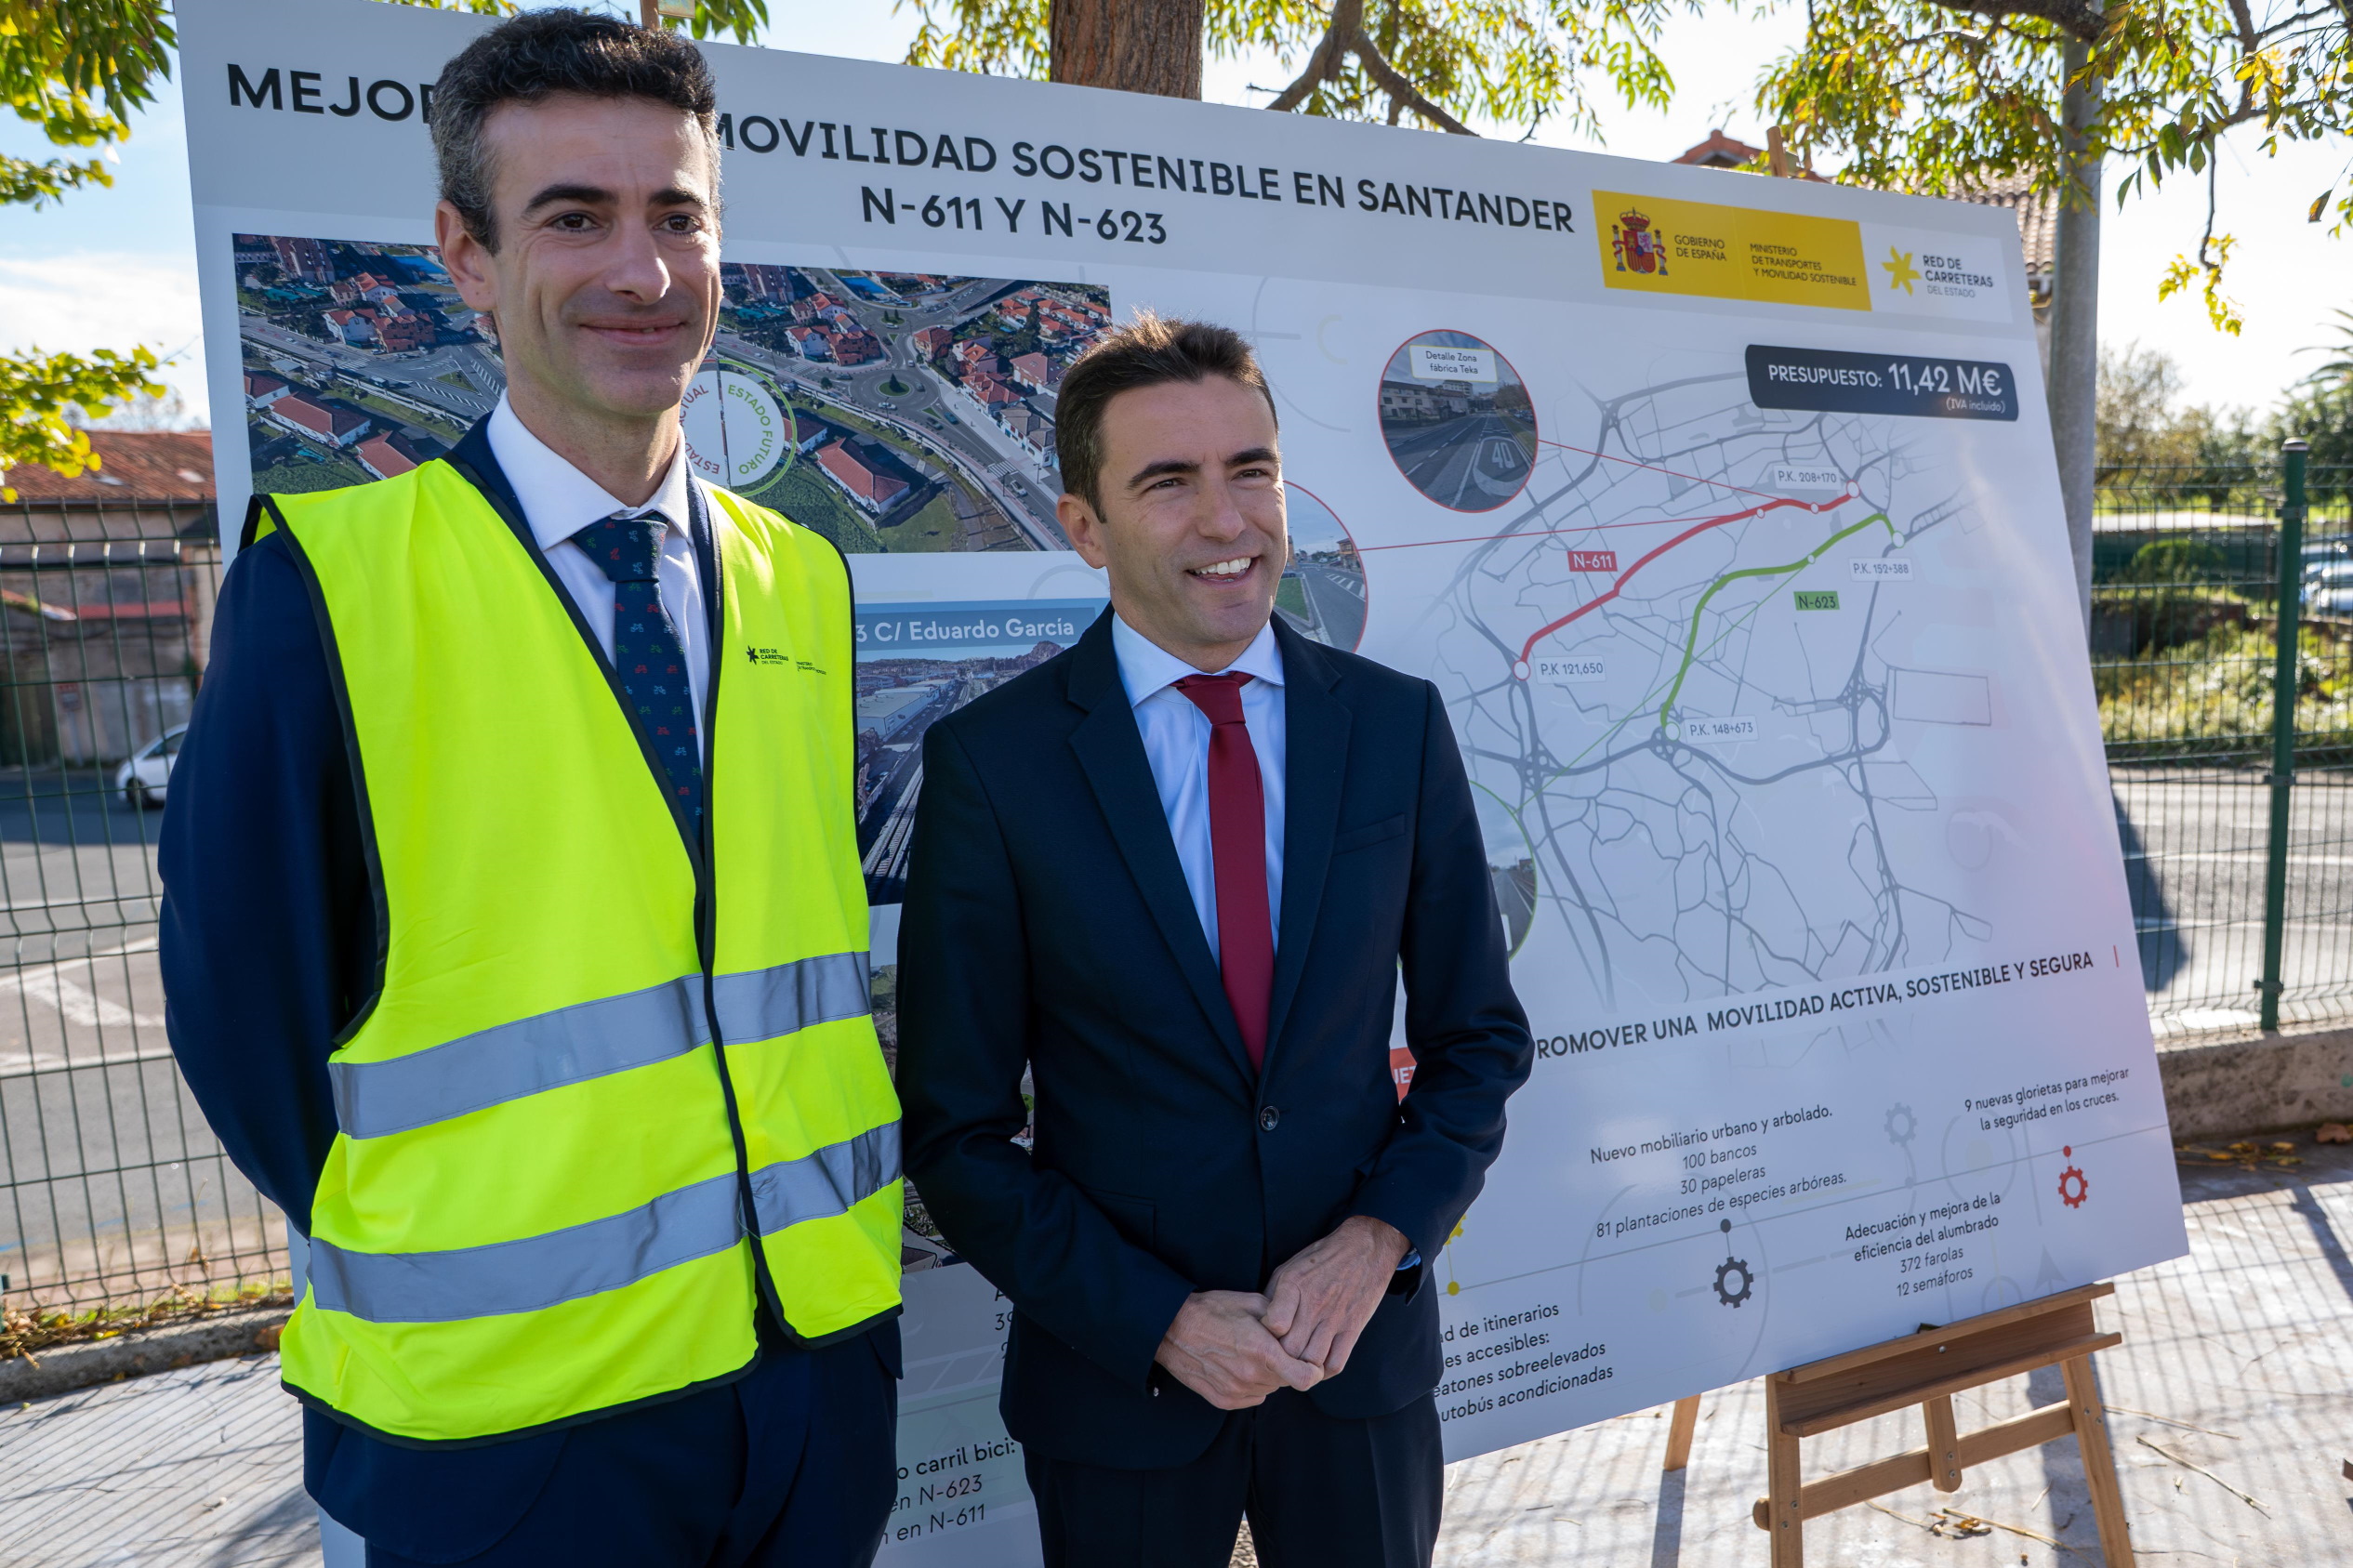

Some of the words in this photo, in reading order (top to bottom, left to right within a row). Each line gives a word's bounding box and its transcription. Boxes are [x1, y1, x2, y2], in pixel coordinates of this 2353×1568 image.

[227, 63, 434, 125] MEJO
[1011, 141, 1281, 202] SOSTENIBLE
[1293, 171, 1345, 209] EN
[1357, 178, 1576, 233] SANTANDER
[861, 186, 983, 231] N-611
[994, 196, 1026, 233] Y
[1041, 201, 1167, 245] N-623
[1674, 234, 1725, 249] GOBIERNO
[1676, 246, 1689, 257] DE
[1691, 249, 1726, 261] ESPAÑA
[1750, 243, 1797, 257] MINISTERIO
[1752, 255, 1764, 265] DE
[1765, 257, 1822, 270] TRANSPORTES
[1753, 268, 1760, 276] Y
[1762, 269, 1808, 281] MOVILIDAD
[1810, 273, 1857, 286] SOSTENIBLE
[1923, 255, 1945, 268] RED
[1947, 257, 1963, 270] DE
[1925, 270, 1993, 288] CARRETERAS
[1927, 284, 1943, 296] DEL
[1944, 286, 1976, 297] ESTADO
[1425, 350, 1456, 361] Detalle
[1457, 352, 1478, 362] Zona
[1430, 362, 1459, 374] fábrica
[1460, 364, 1479, 375] Teka
[1768, 364, 1884, 388] PRESUPUESTO:
[1888, 363, 1951, 396] 11,42
[1956, 365, 2003, 397] M€
[728, 384, 771, 427] ESTADO
[1946, 396, 1968, 411] (IVA
[1969, 399, 2006, 414] incluido)
[684, 433, 720, 475] ESTAD
[738, 429, 773, 476] FUTURO
[1492, 442, 1514, 468] 40
[1778, 470, 1797, 483] P.K.
[1798, 471, 1838, 484] 208+170
[1573, 554, 1613, 570] N-611
[1853, 562, 1871, 574] P.K.
[1798, 595, 1837, 610] N-623
[874, 622, 902, 642] C/
[908, 619, 999, 641] Eduardo
[1005, 617, 1075, 639] García
[1540, 662, 1560, 677] P.K
[1562, 661, 1604, 676] 121,650
[1689, 724, 1712, 737] P.K.
[1712, 722, 1754, 735] 148+673
[1536, 1023, 1648, 1060] ROMOVER
[1652, 1015, 1699, 1040] UNA
[1707, 994, 1826, 1033] MOVILIDAD
[1830, 983, 1903, 1013] ACTIVA,
[1906, 965, 2011, 999] SOSTENIBLE
[2014, 964, 2026, 981] Y
[2029, 951, 2094, 978] SEGURA
[1964, 1099, 1972, 1113] 9
[1976, 1092, 2013, 1111] nuevas
[2016, 1084, 2063, 1106] glorietas
[2065, 1077, 2089, 1095] para
[2090, 1068, 2130, 1087] mejorar
[1980, 1117, 1991, 1131] la
[1993, 1104, 2048, 1130] seguridad
[2049, 1105, 2064, 1116] en
[2065, 1099, 2082, 1113] los
[2082, 1092, 2120, 1108] cruces.
[1590, 1144, 1636, 1165] Nuevo
[1640, 1128, 1709, 1154] mobiliario
[1712, 1121, 1758, 1140] urbano
[1761, 1119, 1768, 1134] y
[1772, 1104, 1833, 1127] arbolado.
[1682, 1153, 1706, 1170] 100
[1710, 1144, 1758, 1165] bancos
[1680, 1179, 1698, 1195] 30
[1700, 1166, 1766, 1194] papeleras
[1595, 1221, 1613, 1238] 81
[1615, 1204, 1704, 1239] plantaciones
[1707, 1197, 1725, 1214] de
[1728, 1186, 1786, 1210] especies
[1789, 1172, 1847, 1195] arbóreas.
[1844, 1213, 1917, 1242] Adecuación
[1919, 1212, 1927, 1228] y
[1929, 1201, 1970, 1222] mejora
[1972, 1194, 1988, 1210] de
[1989, 1191, 2001, 1206] la
[1854, 1237, 1913, 1262] eficiencia
[1915, 1229, 1936, 1247] del
[1937, 1214, 2000, 1242] alumbrado
[1899, 1255, 1922, 1274] 372
[1923, 1245, 1964, 1268] farolas
[1896, 1281, 1910, 1298] 12
[1912, 1267, 1974, 1294] semáforos
[1459, 1321, 1480, 1339] de
[1483, 1303, 1560, 1333] itinerarios
[1466, 1332, 1551, 1364] accesibles:
[1434, 1371, 1495, 1399] eatones
[1498, 1341, 1606, 1382] sobreelevados
[1441, 1395, 1494, 1423] utobús
[1498, 1364, 1614, 1408] acondicionadas
[915, 1446, 969, 1476] carril
[973, 1436, 1016, 1462] bici:
[919, 1473, 983, 1506] N-623
[896, 1523, 921, 1541] en
[930, 1503, 985, 1534] N-611
